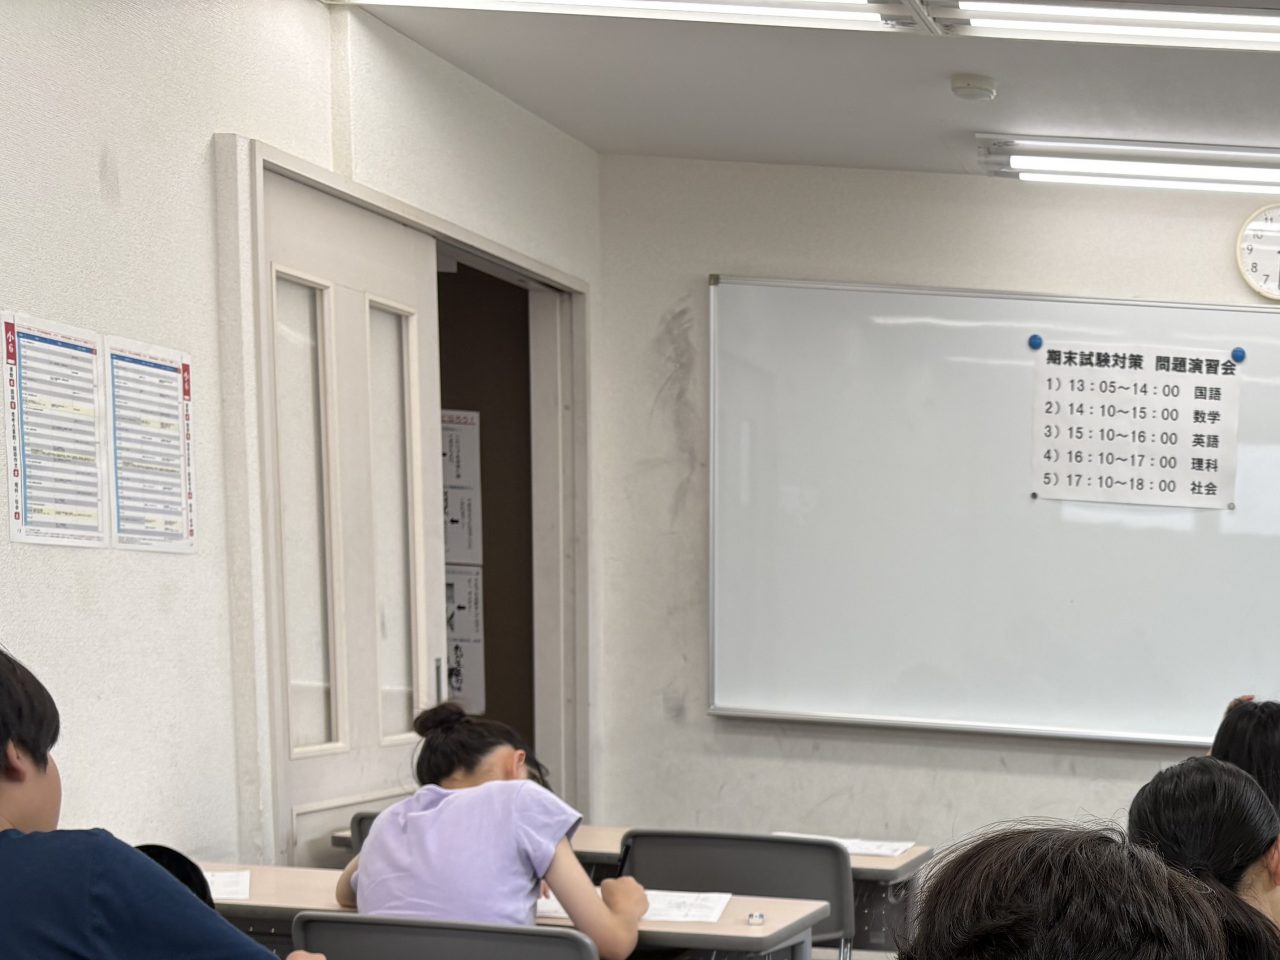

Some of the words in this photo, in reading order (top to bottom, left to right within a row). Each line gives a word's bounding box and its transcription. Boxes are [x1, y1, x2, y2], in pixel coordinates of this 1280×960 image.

[1246, 245, 1253, 254] 9
[1251, 262, 1258, 273] 8
[1262, 274, 1270, 284] 7
[1046, 350, 1144, 370] 期末試験対策
[1155, 355, 1237, 376] 問題演習会
[1194, 386, 1222, 401] 国語
[1193, 409, 1221, 425] 数学
[1192, 433, 1219, 449] 英語
[1191, 458, 1218, 473] 理科
[1190, 481, 1217, 496] 社会
